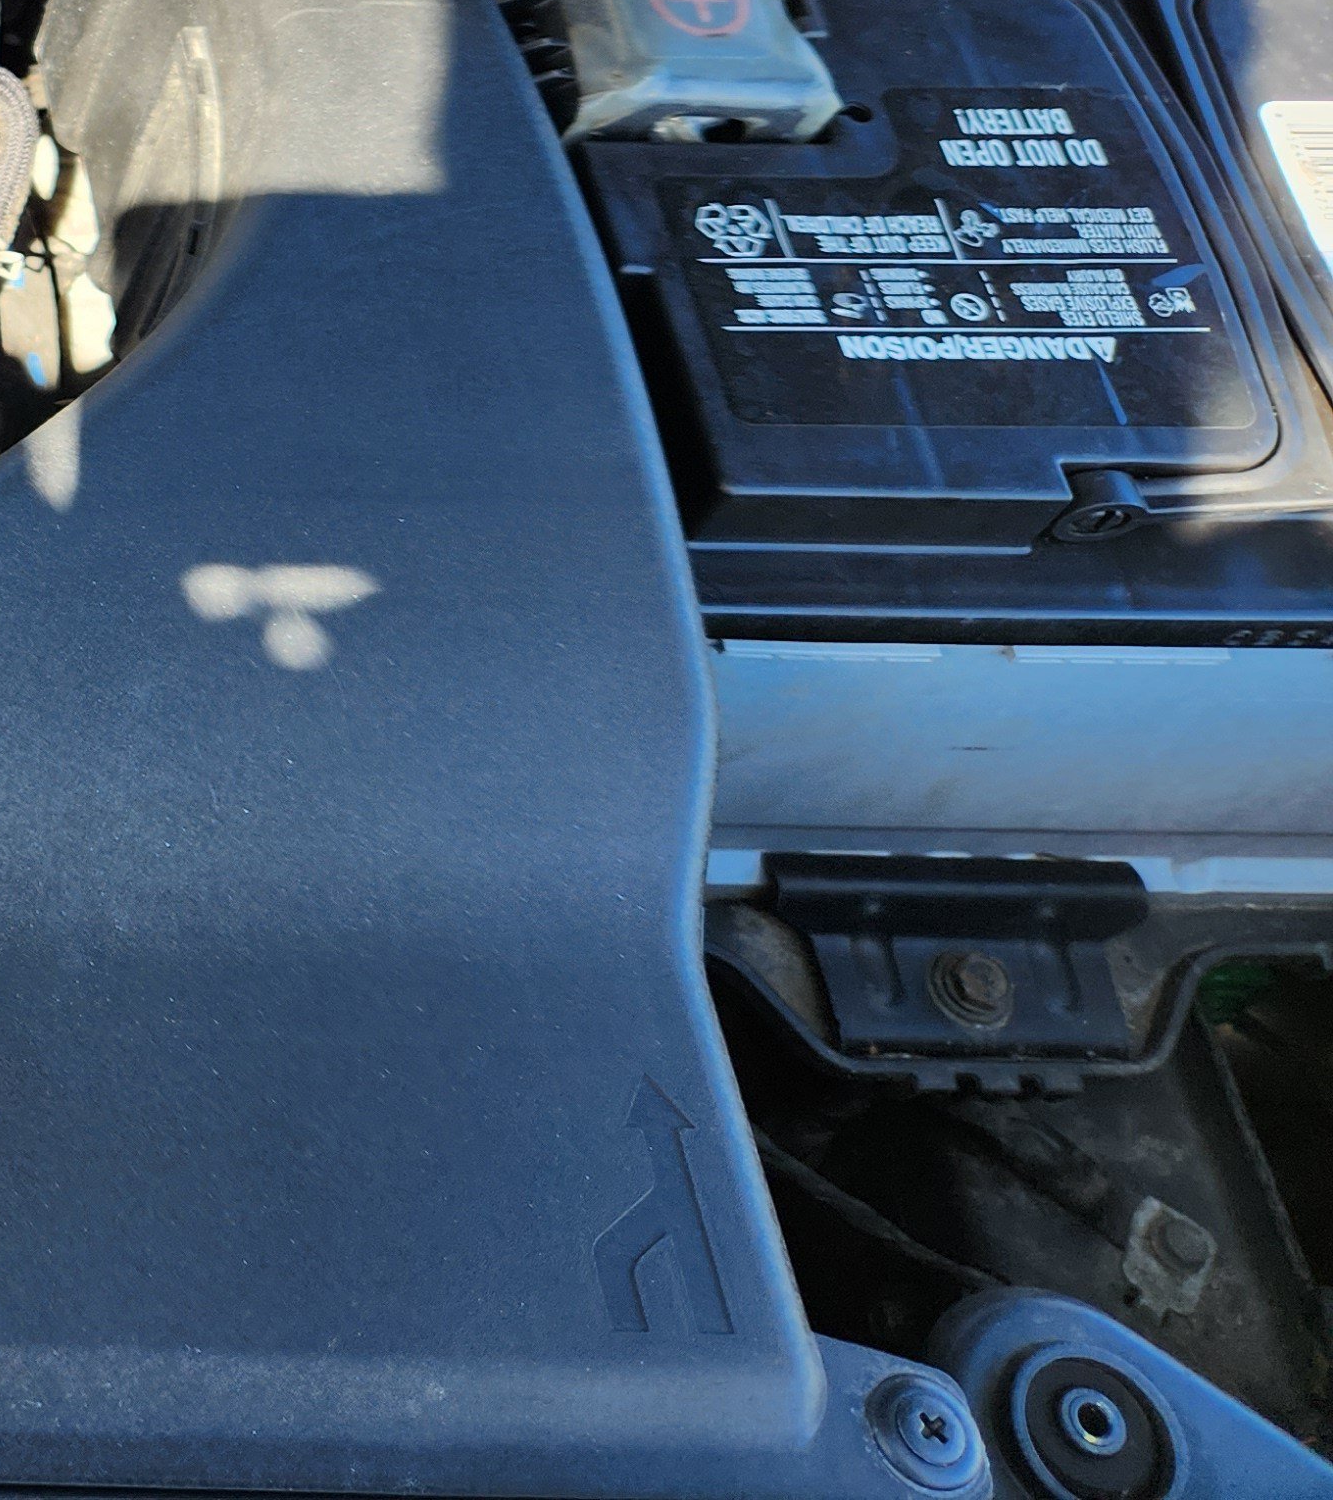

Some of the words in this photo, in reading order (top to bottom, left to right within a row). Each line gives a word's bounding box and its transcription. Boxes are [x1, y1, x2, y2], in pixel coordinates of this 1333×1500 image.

[953, 108, 1074, 135] BATTERY!
[939, 139, 1014, 167] OPEN
[1011, 139, 1067, 167] NOT
[1064, 138, 1109, 166] DO
[1033, 207, 1069, 223] HELP
[1069, 207, 1126, 223] MEDICAL
[1126, 207, 1154, 223] GET
[1125, 223, 1162, 238] WITH
[1001, 238, 1090, 254] IMMEDIATELY
[1090, 238, 1122, 254] EYES
[1122, 238, 1169, 254] FLUSH
[1020, 296, 1066, 311] GASES
[1065, 296, 1139, 311] EXPLOSIVE
[1059, 310, 1096, 326] EYES
[1095, 310, 1145, 326] SHIELD
[837, 335, 1098, 362] DANGER/POISON
